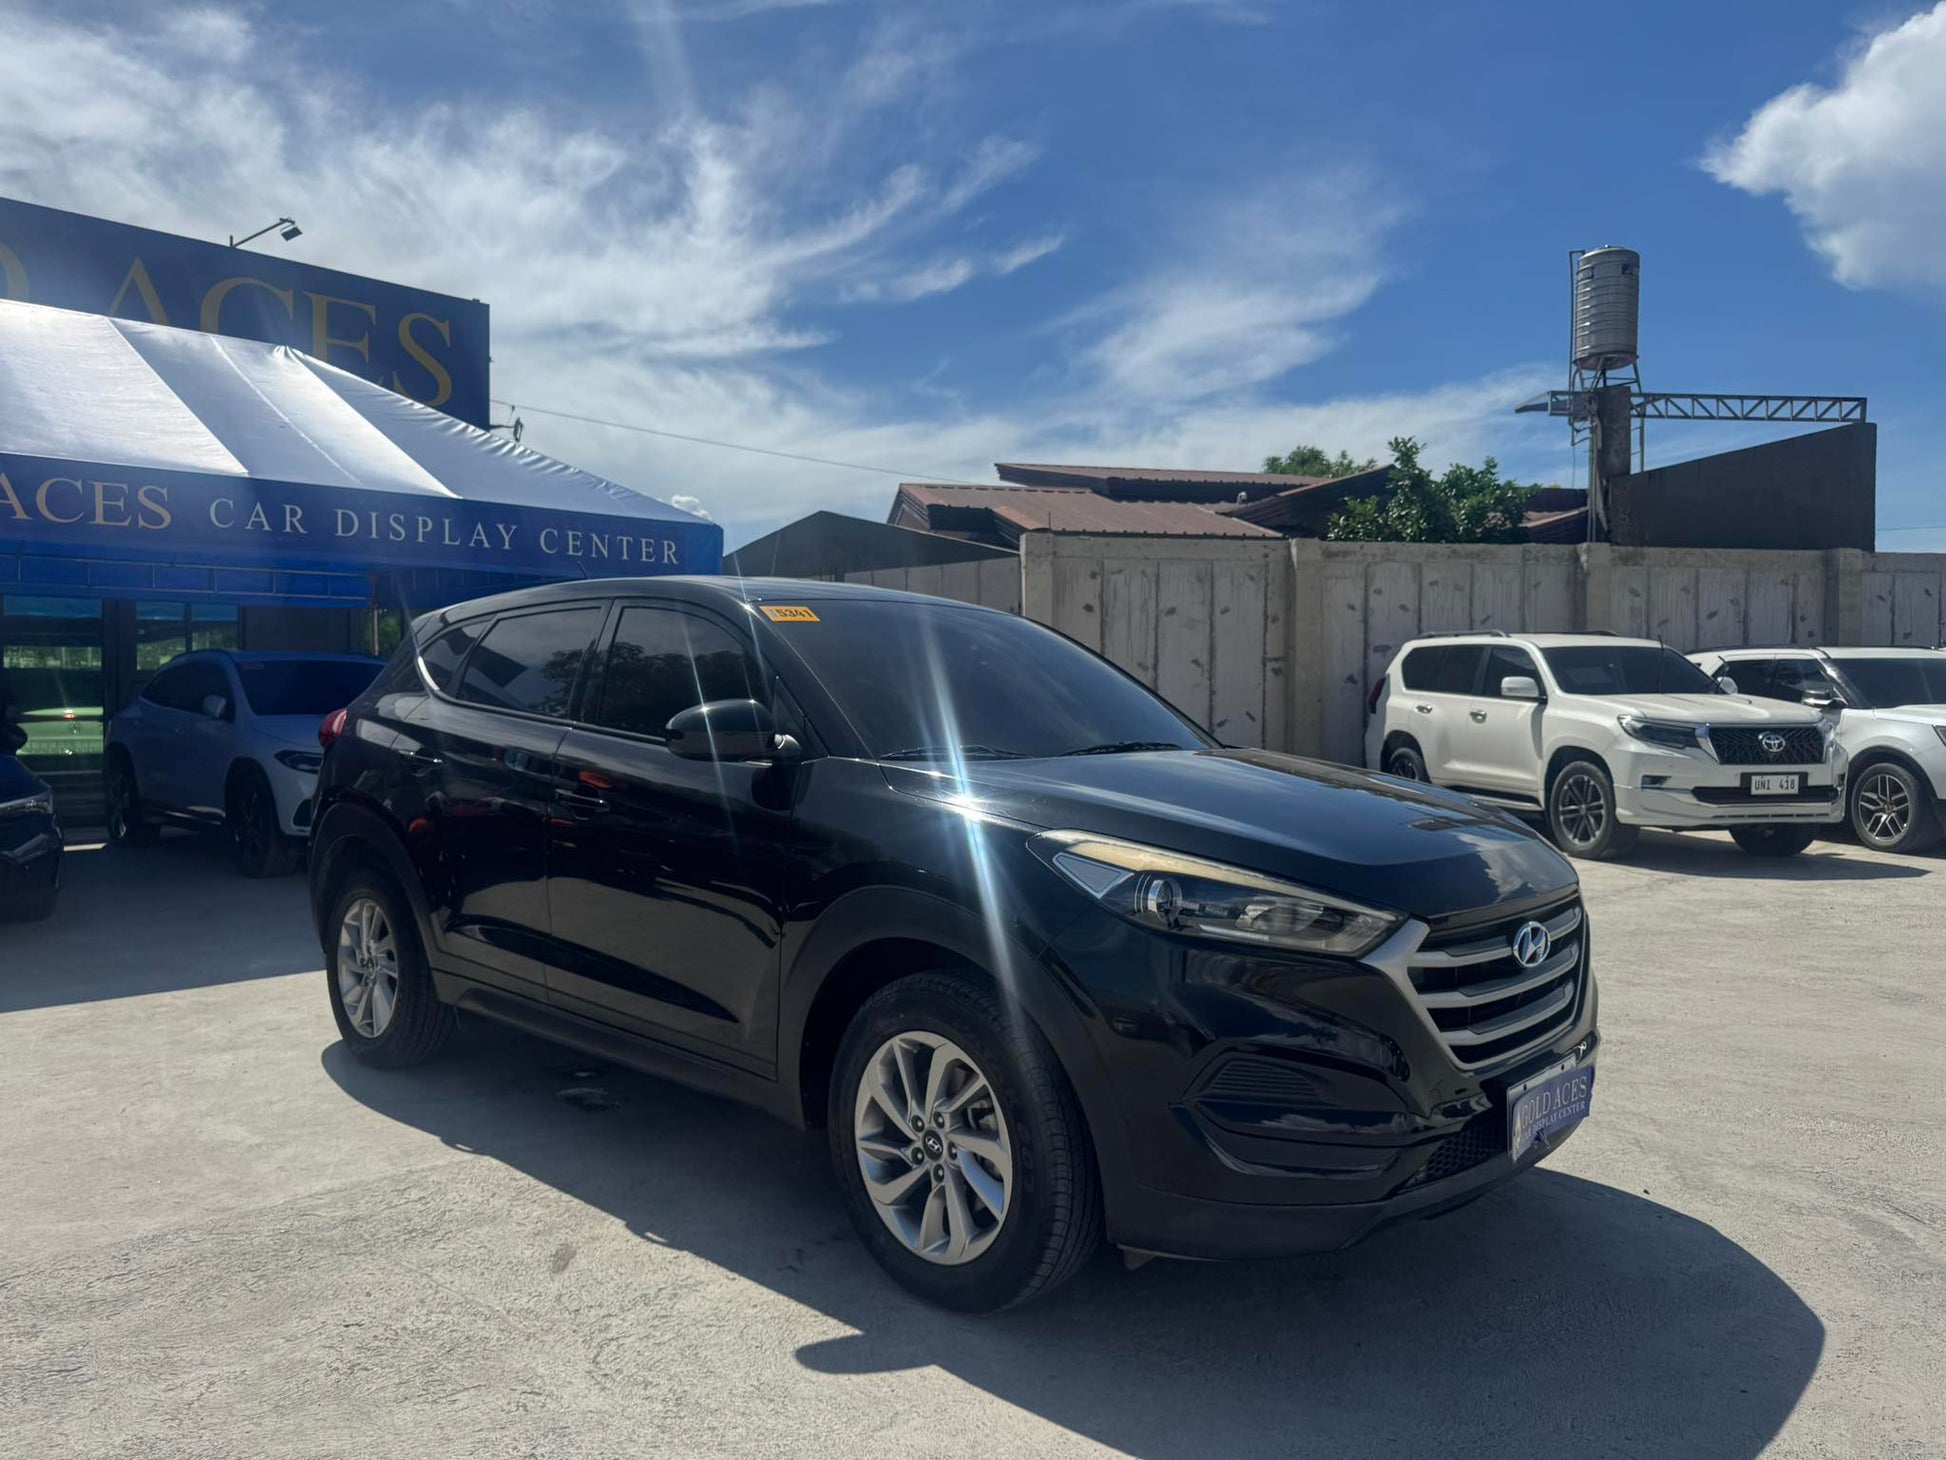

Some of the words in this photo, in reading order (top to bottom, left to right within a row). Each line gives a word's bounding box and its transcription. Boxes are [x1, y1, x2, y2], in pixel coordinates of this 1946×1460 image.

[209, 498, 308, 534] CAR
[335, 508, 518, 550] DISPLAY
[540, 528, 679, 565] CENTER
[1754, 779, 1770, 790] UNI
[1779, 779, 1795, 790] 418
[1521, 1091, 1551, 1129] GOLD
[1553, 1076, 1587, 1110] ACES
[1558, 1101, 1586, 1118] CENTER
